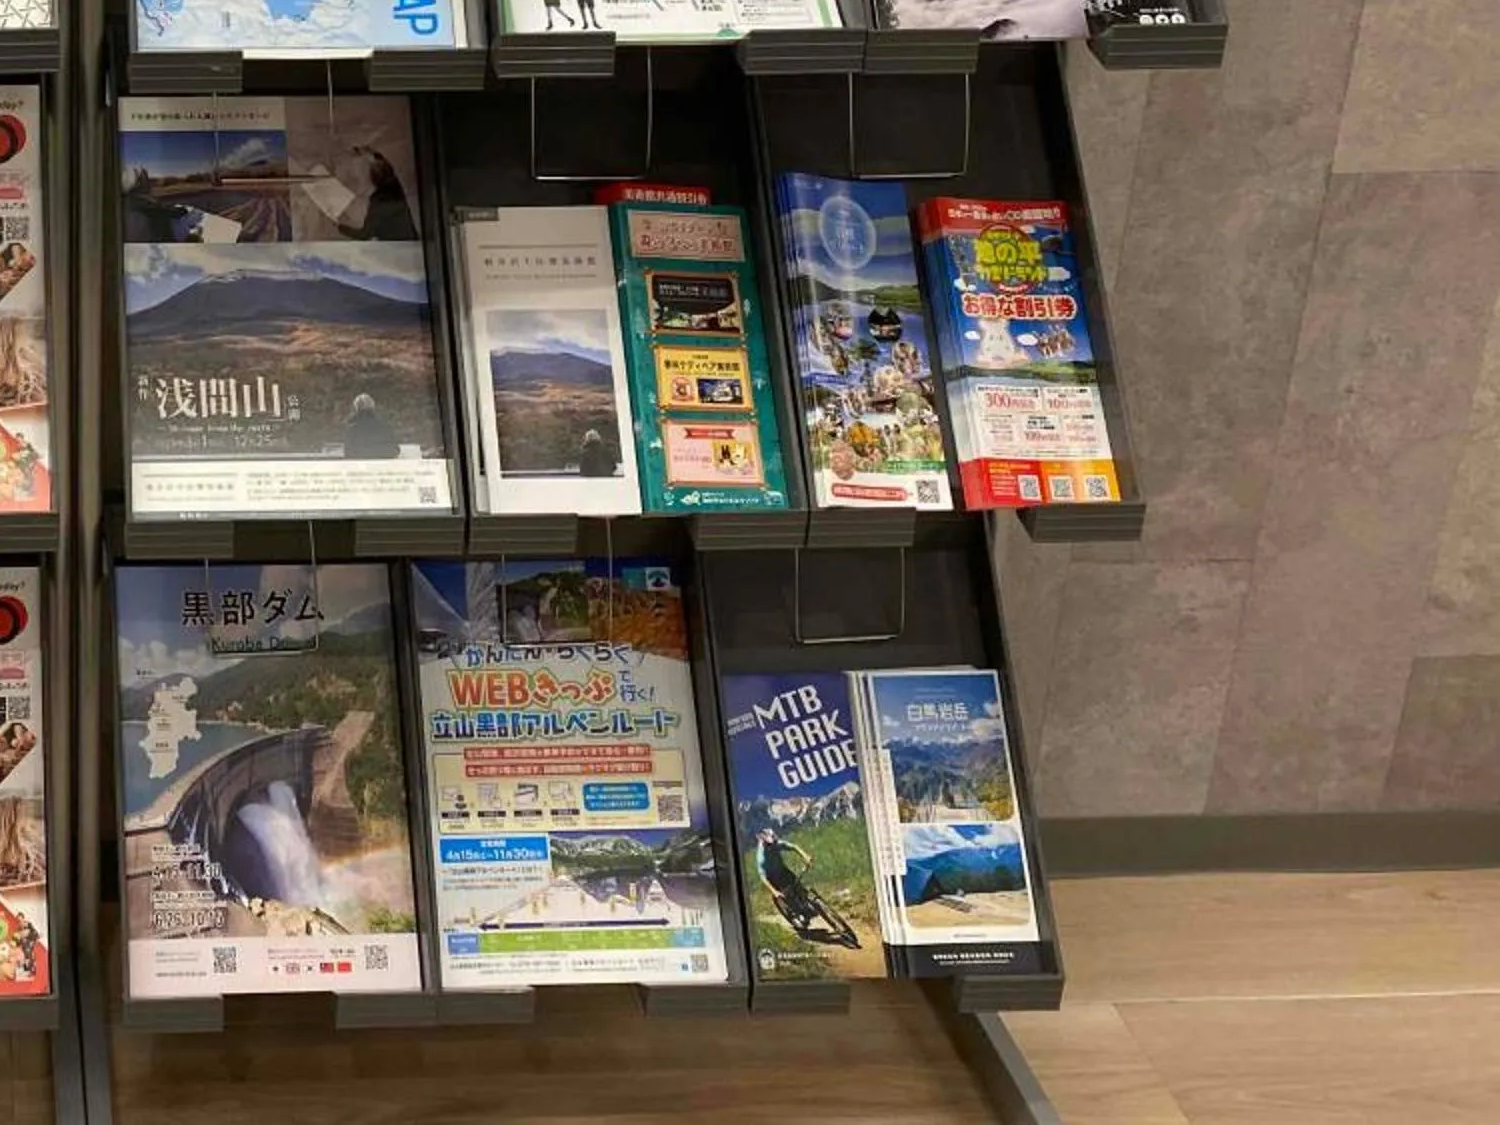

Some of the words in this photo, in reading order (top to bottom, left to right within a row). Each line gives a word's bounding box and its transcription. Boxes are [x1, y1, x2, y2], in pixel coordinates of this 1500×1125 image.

[962, 293, 1077, 319] お得な割引券
[155, 376, 282, 420] 浅間山
[181, 589, 326, 626] 黒部ダム
[449, 668, 615, 706] WEBきっぷ
[753, 684, 823, 730] MTB
[432, 708, 678, 739] 立山黒部アルペンルート
[764, 709, 849, 760] PARK
[776, 738, 859, 790] GUIDE
